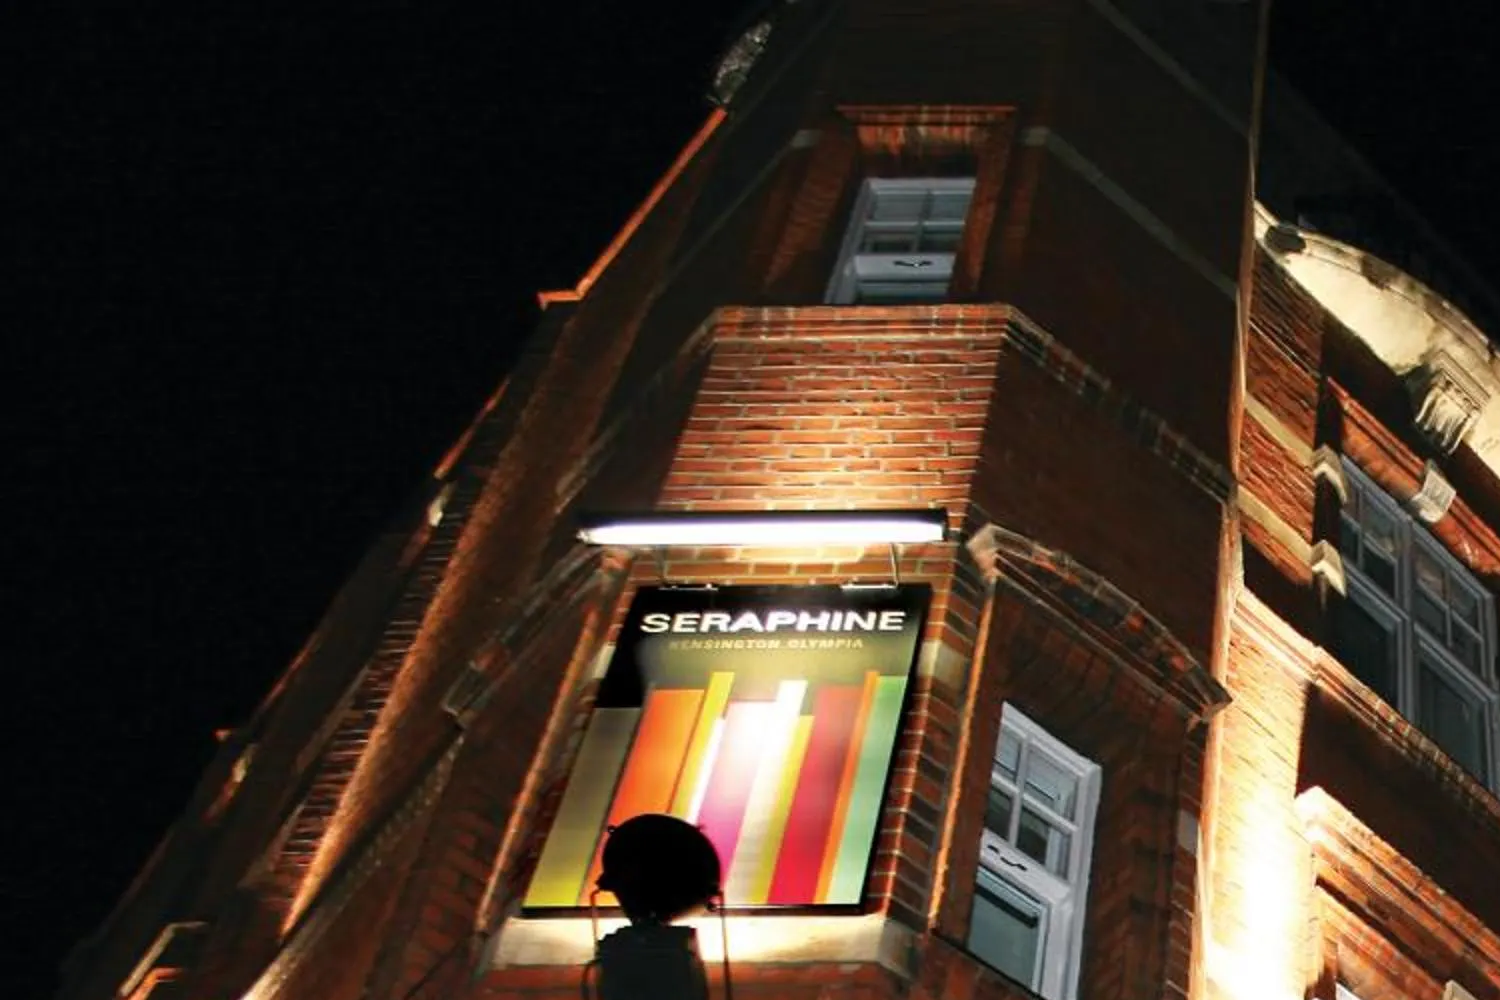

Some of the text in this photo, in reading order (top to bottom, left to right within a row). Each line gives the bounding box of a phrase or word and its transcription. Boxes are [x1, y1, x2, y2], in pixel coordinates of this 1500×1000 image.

[640, 610, 906, 633] SERAPHINE
[669, 637, 864, 650] KENSINGTON OLYMPIA
